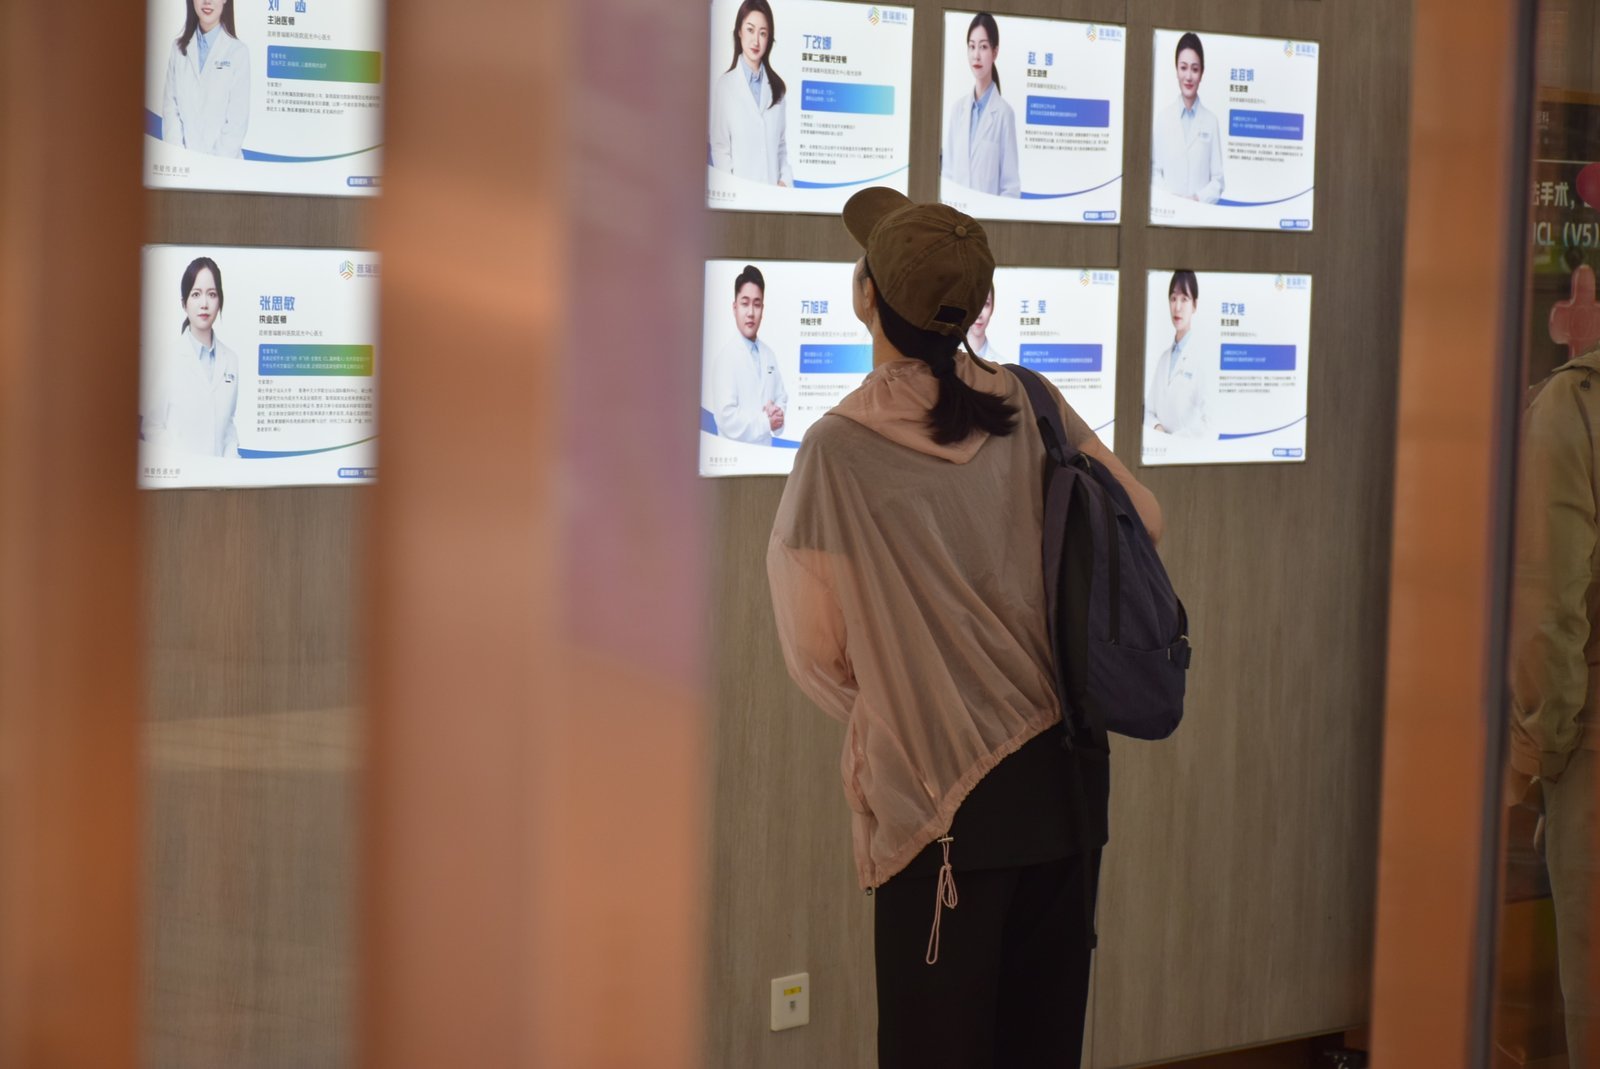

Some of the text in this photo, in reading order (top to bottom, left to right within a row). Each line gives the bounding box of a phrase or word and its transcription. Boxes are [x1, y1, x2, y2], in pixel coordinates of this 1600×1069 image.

[267, 15, 295, 26] 主治医师
[259, 295, 296, 311] 张思敏
[259, 315, 287, 324] 执业医师
